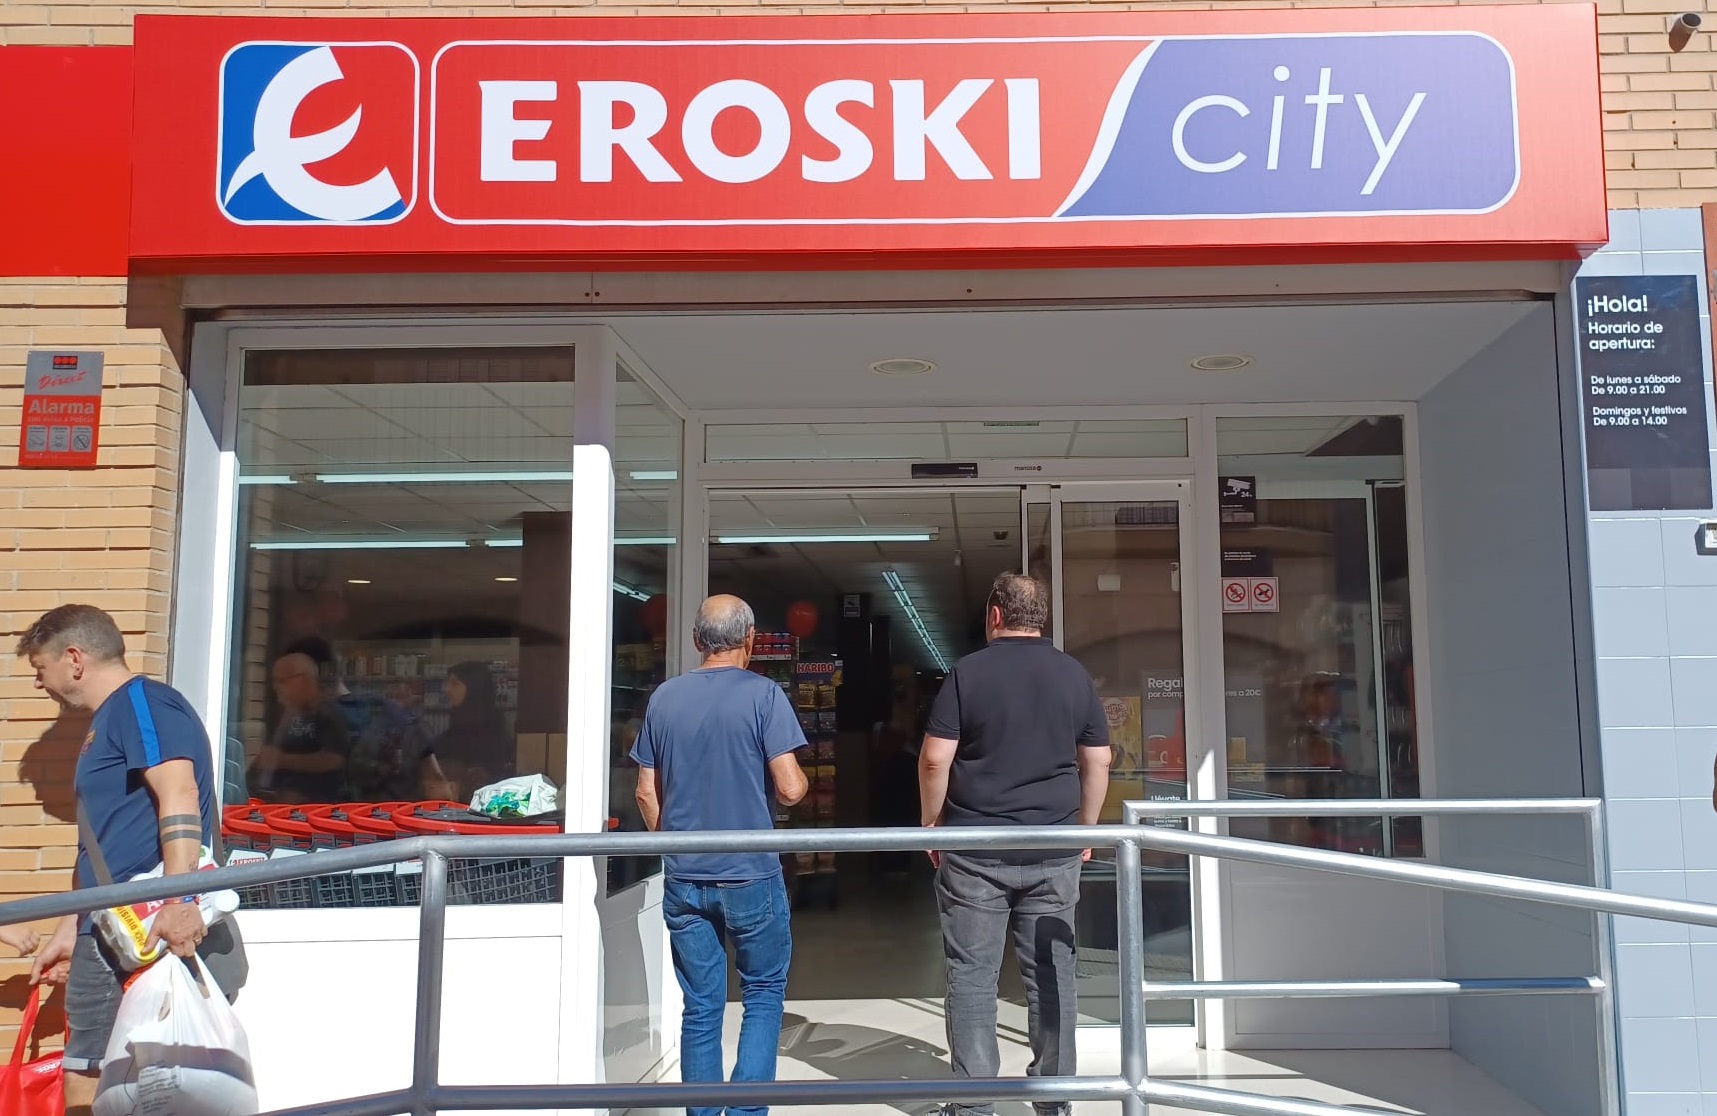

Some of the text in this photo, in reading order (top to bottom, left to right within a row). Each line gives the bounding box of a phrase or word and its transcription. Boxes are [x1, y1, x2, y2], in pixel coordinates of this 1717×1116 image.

[478, 65, 1427, 196] EROSKI city
[1587, 294, 1648, 317] ¡Hola!
[1588, 321, 1664, 334] Horario de
[1589, 336, 1655, 352] apertura:
[1590, 374, 1682, 384] De lunes a sábado
[1591, 385, 1666, 394] De 9.00 a 21.00
[29, 399, 94, 414] Alarma
[1592, 406, 1688, 417] Domingos y festivos
[1593, 416, 1668, 426] De 9.00 a 14.00
[797, 662, 834, 674] HARIBO
[1148, 690, 1160, 699] por
